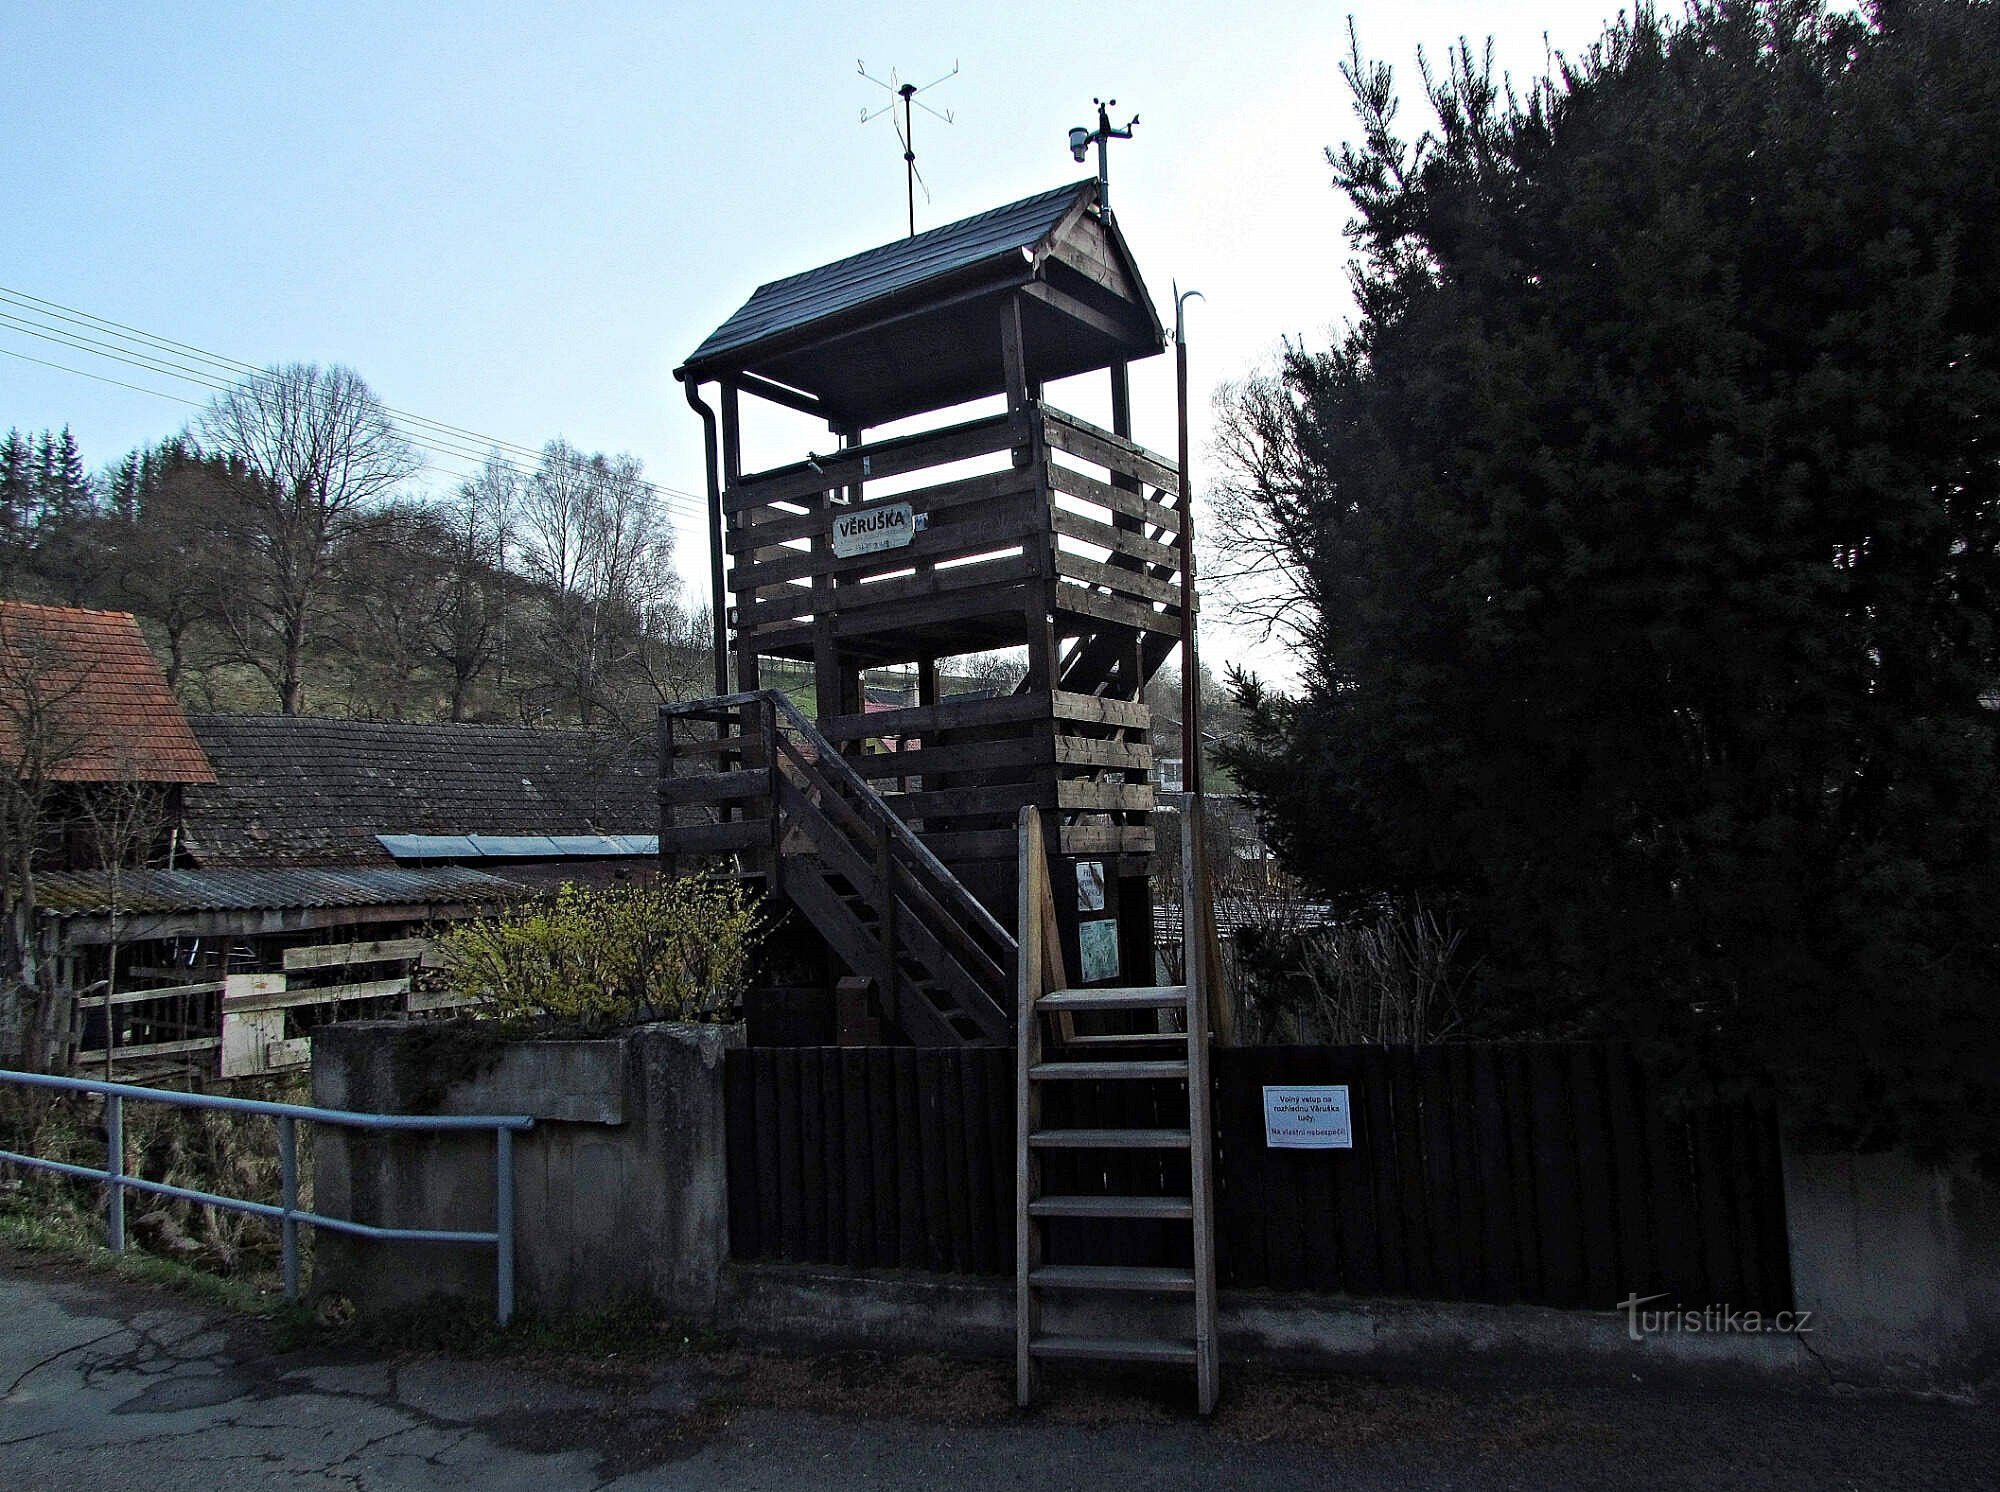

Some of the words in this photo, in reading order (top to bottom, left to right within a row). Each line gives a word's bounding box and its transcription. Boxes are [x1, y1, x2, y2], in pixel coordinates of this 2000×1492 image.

[839, 509, 905, 537] VĚRUŠKA
[1279, 1095, 1300, 1105] Volný
[1302, 1096, 1321, 1104] vstup
[1273, 1105, 1308, 1113] rozhlednu
[1310, 1104, 1340, 1113] Věruška
[1271, 1128, 1281, 1136] Na
[1282, 1128, 1306, 1136] vlastní
